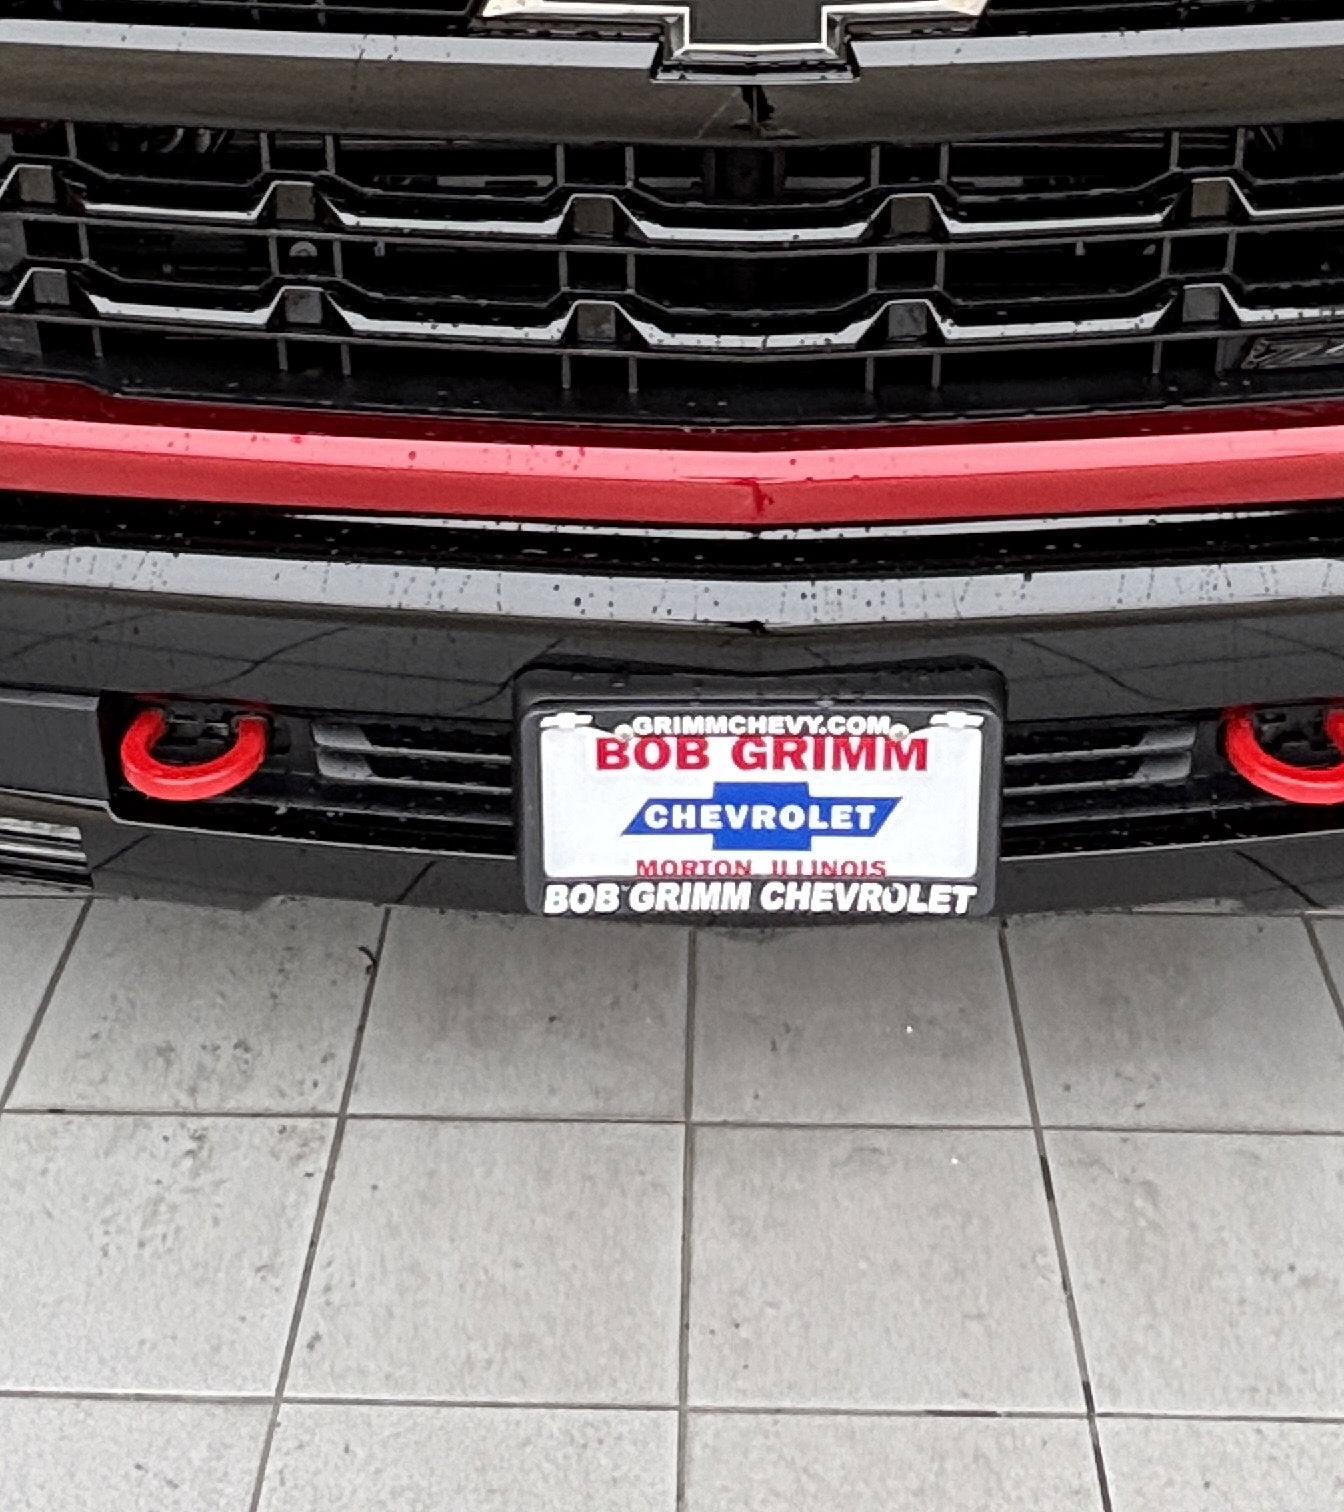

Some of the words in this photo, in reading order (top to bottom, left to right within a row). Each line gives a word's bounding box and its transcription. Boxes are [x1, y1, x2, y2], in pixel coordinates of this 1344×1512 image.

[632, 714, 892, 737] GRIMMCHEVY.COM
[596, 735, 710, 771] BOB
[731, 734, 928, 772] GRIMM
[644, 803, 876, 830] CHEVROLET
[636, 859, 752, 878] MORTON
[771, 859, 887, 878] ILLINOIS
[543, 882, 621, 915] BOB
[629, 880, 752, 913] GRIMM
[760, 880, 978, 915] CHEVROLET
